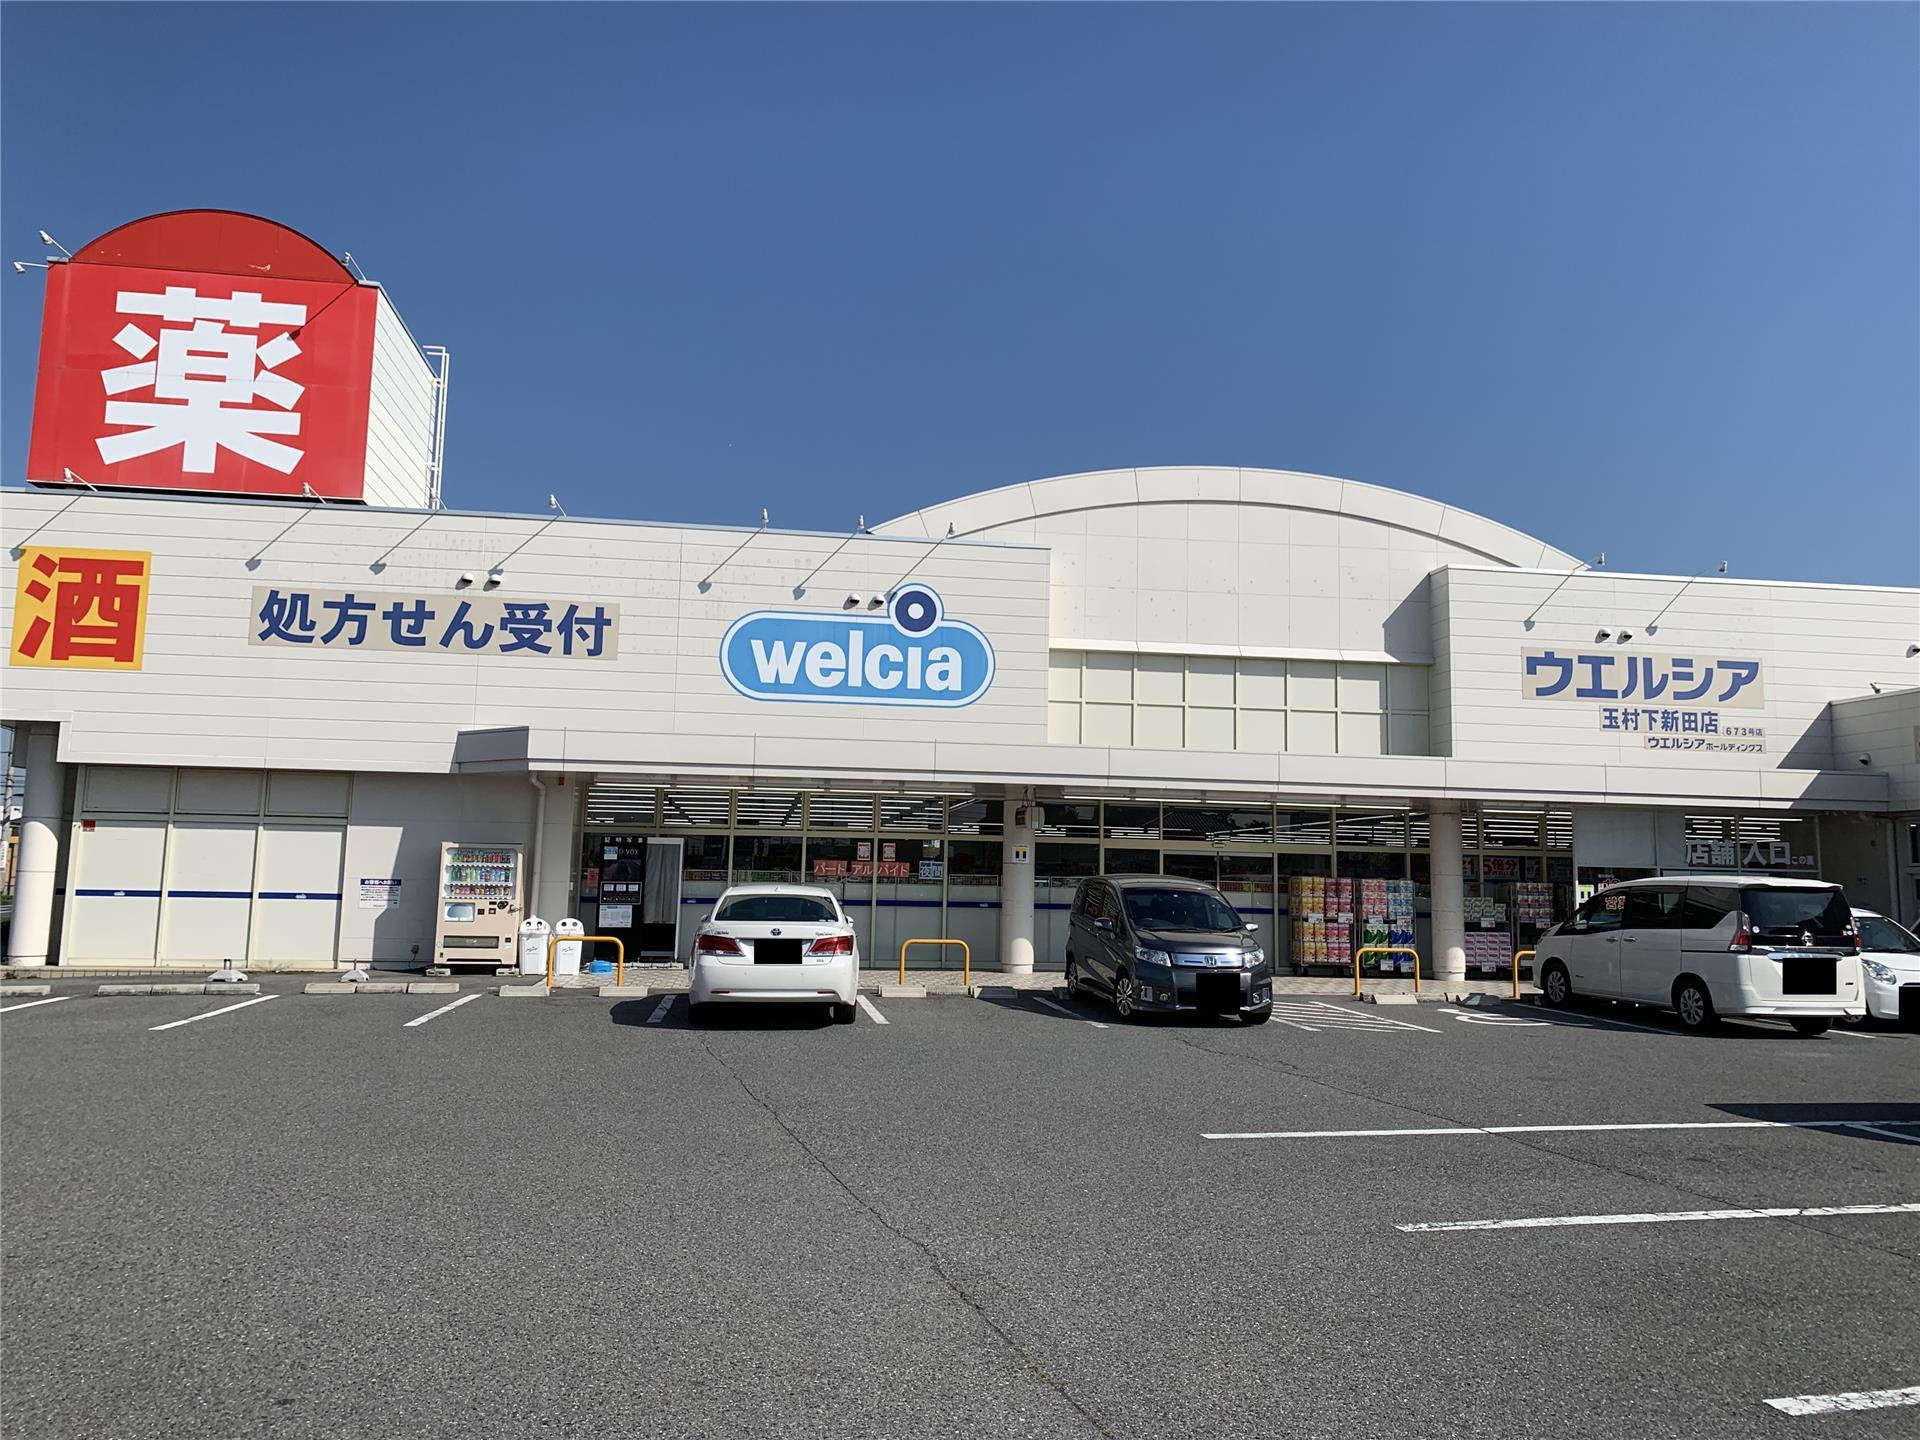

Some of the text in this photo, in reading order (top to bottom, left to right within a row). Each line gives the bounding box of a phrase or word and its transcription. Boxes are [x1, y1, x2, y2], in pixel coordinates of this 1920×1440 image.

[95, 286, 308, 475] 薬
[18, 553, 145, 663] 酒
[258, 588, 612, 657] 処方せん受付
[750, 591, 963, 692] welcia
[1525, 650, 1760, 702] ウエルシア
[1602, 708, 1719, 735] 玉村下新田店
[1725, 727, 1763, 736] 673号店
[814, 862, 847, 876] パート
